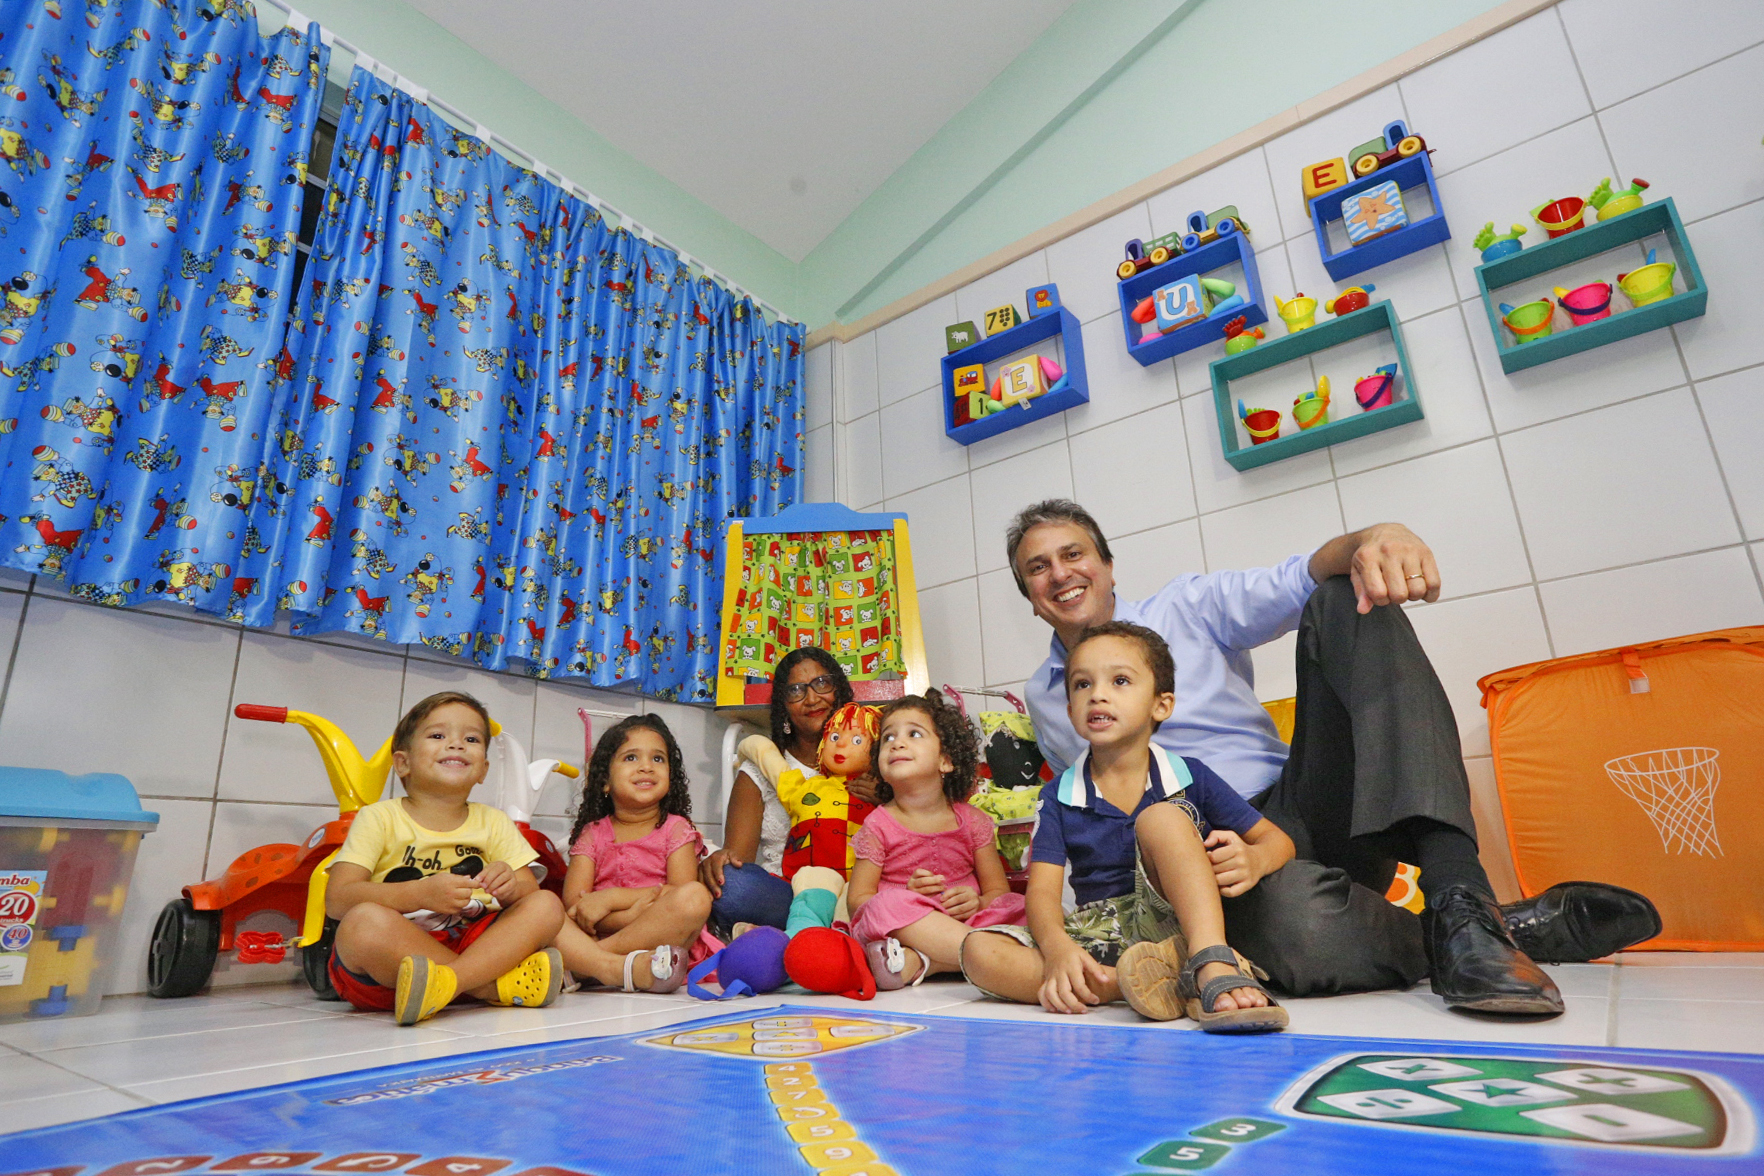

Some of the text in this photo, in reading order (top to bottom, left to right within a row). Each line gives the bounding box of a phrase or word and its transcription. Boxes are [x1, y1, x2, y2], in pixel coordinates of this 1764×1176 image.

[1312, 162, 1338, 189] E
[1165, 286, 1188, 316] U
[987, 311, 998, 331] 7
[1010, 365, 1028, 393] E
[978, 397, 984, 415] 1
[0, 896, 30, 916] 20
[7, 928, 28, 939] 40
[778, 1064, 796, 1072] 4
[783, 1077, 802, 1085] 2
[809, 1125, 835, 1137] 5
[1220, 1122, 1256, 1136] 3
[825, 1147, 852, 1160] 9
[1169, 1146, 1204, 1161] 5
